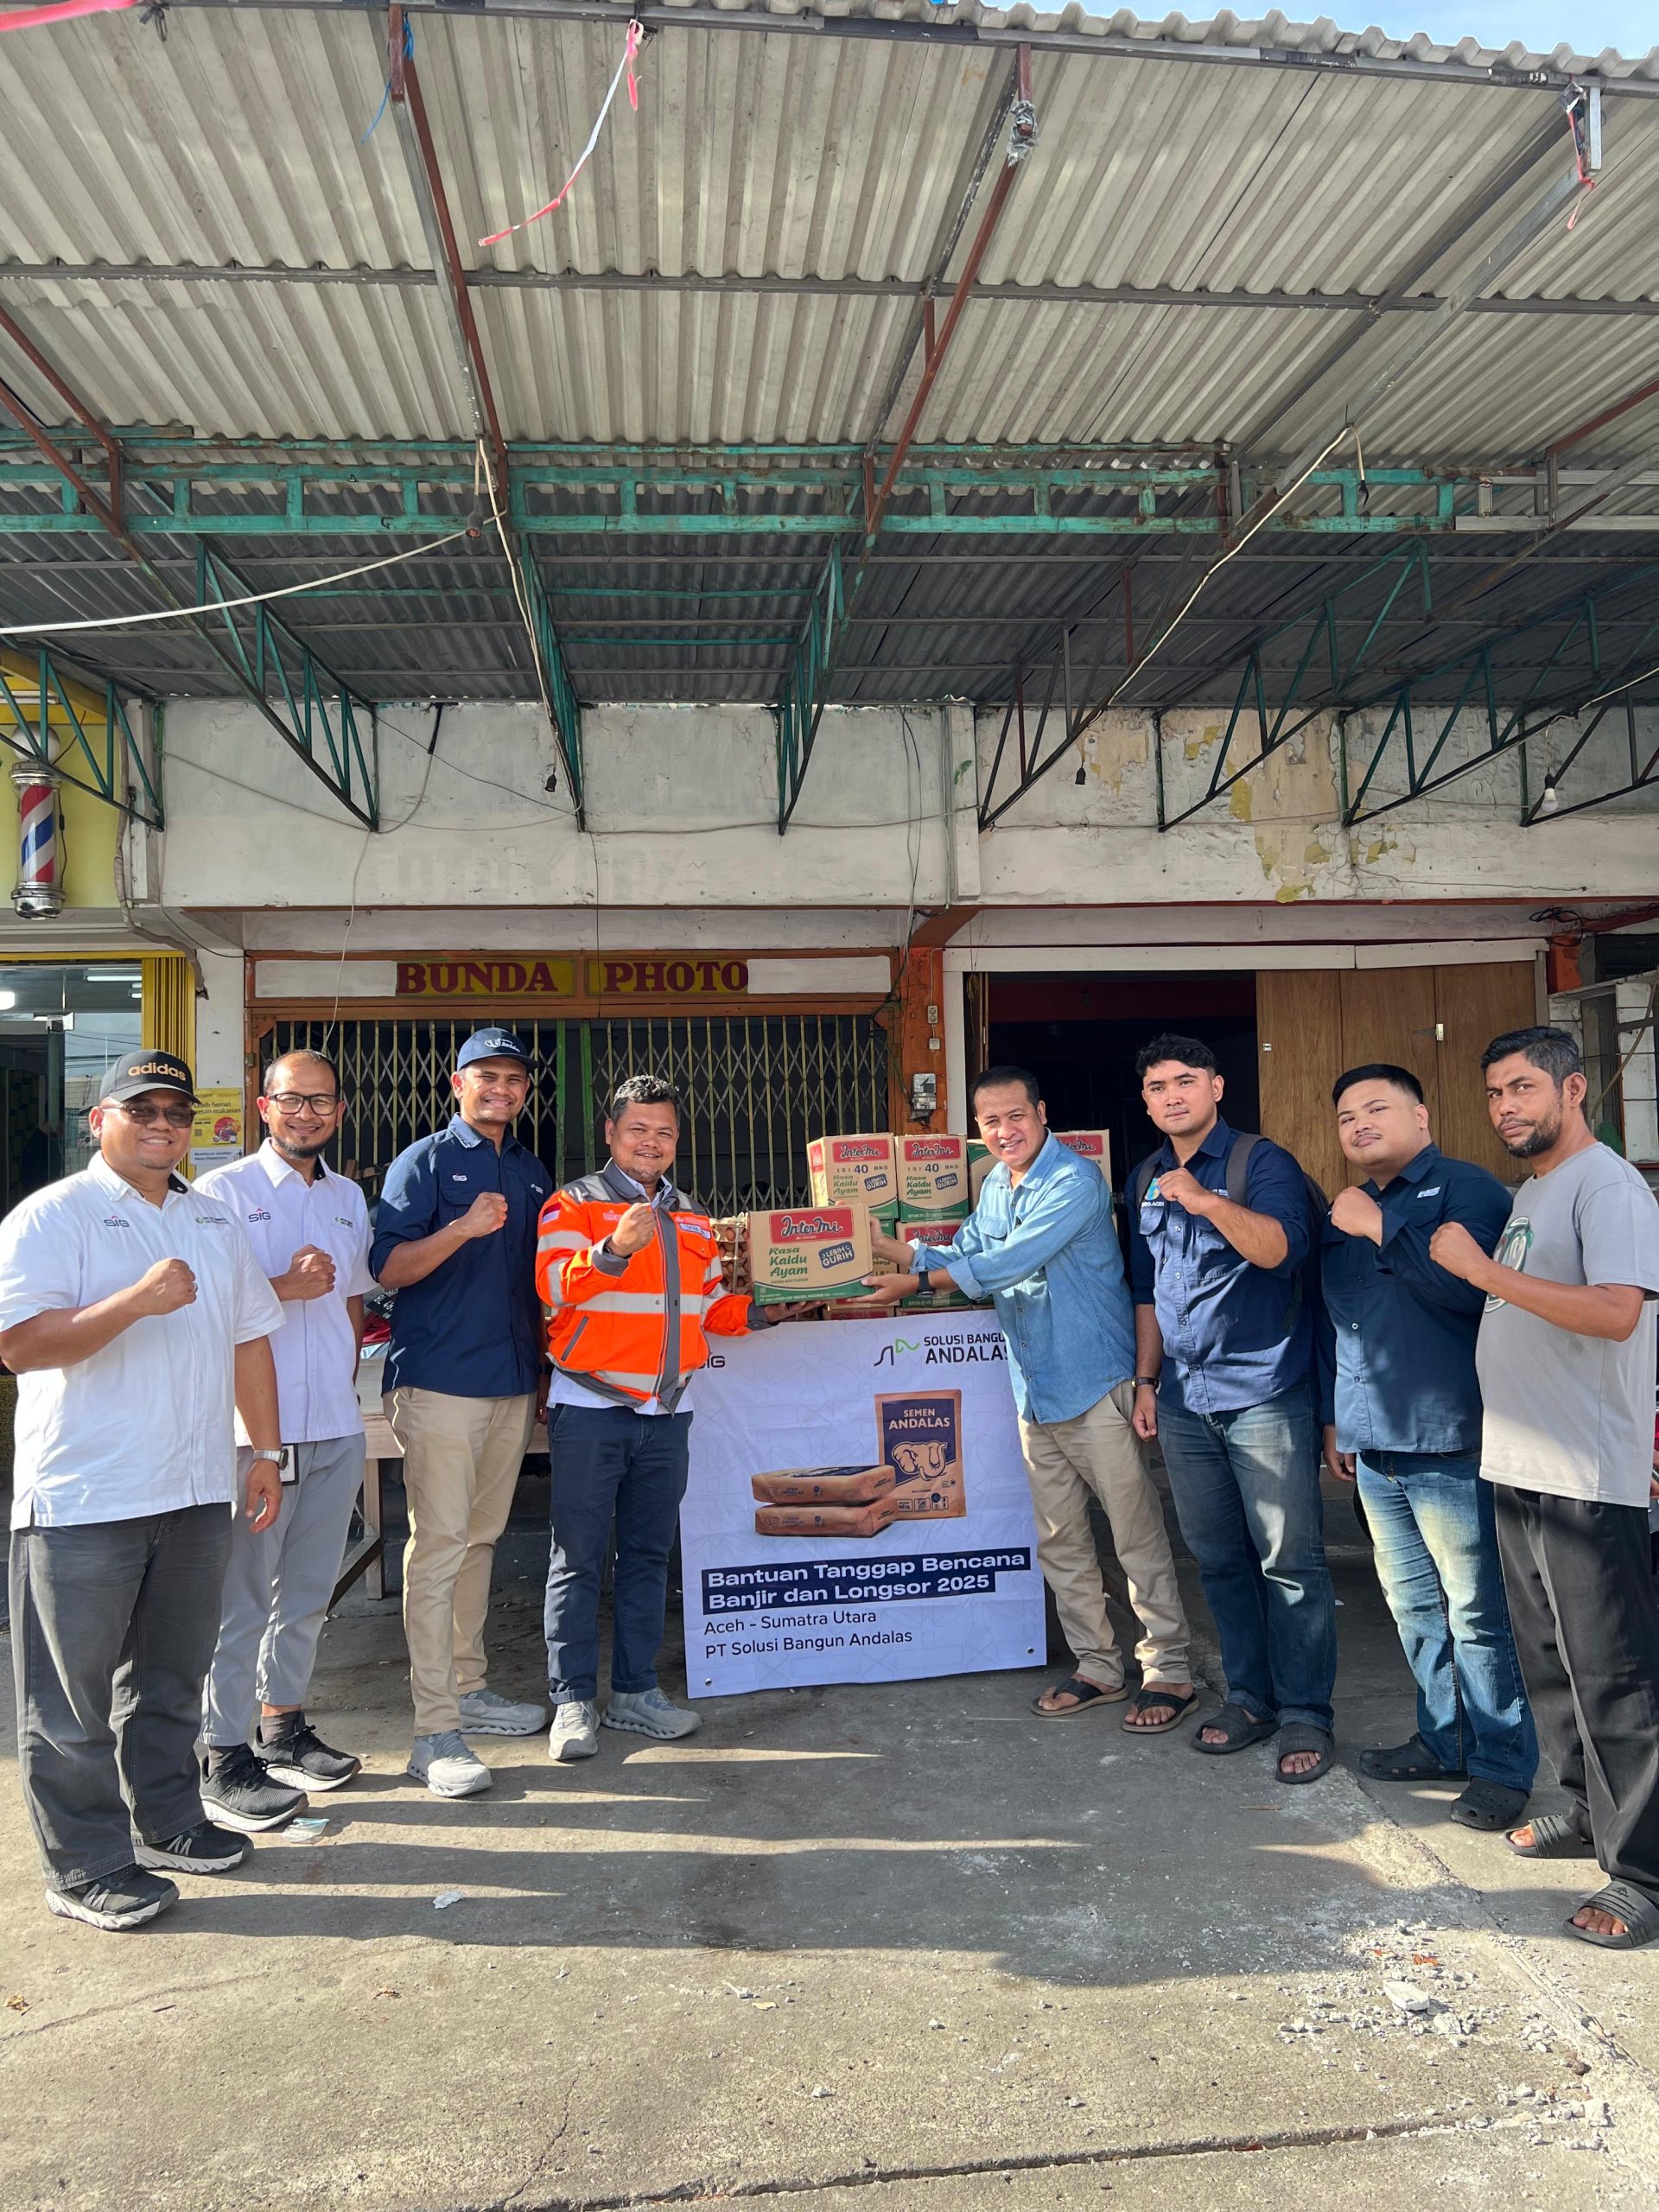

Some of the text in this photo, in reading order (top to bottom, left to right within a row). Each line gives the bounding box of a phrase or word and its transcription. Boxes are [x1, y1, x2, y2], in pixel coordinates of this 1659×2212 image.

[398, 961, 748, 993] BUNDA PHOTO
[128, 1062, 187, 1081] adidas
[840, 1143, 882, 1159] InterMi
[911, 1141, 954, 1158] InterMi
[854, 1165, 868, 1173] 40
[925, 1163, 939, 1173] 40
[833, 1187, 858, 1196] Ayam
[866, 1179, 887, 1190] GURIH
[104, 1217, 130, 1228] SIG
[248, 1209, 271, 1223] SIG
[781, 1215, 843, 1237] InterMi
[823, 1249, 853, 1266] GURIH
[827, 1246, 845, 1257] LEBIH
[769, 1255, 807, 1266] Kaldu
[770, 1267, 808, 1279] Ayam
[924, 1332, 1006, 1346] SOLUSI BANGU
[698, 1356, 725, 1369] IG
[903, 1408, 935, 1418] SEMEN
[889, 1417, 950, 1430] ANDALAS
[709, 1554, 1025, 1588] Bantuan Tanggap Bencana
[709, 1574, 989, 1609] Banjir dan Longsor 2025
[704, 1618, 745, 1635] Aceh
[761, 1613, 828, 1629] Sumatra
[834, 1611, 876, 1624] Utara
[706, 1630, 912, 1659] PT Solusi Bangun Andalas
